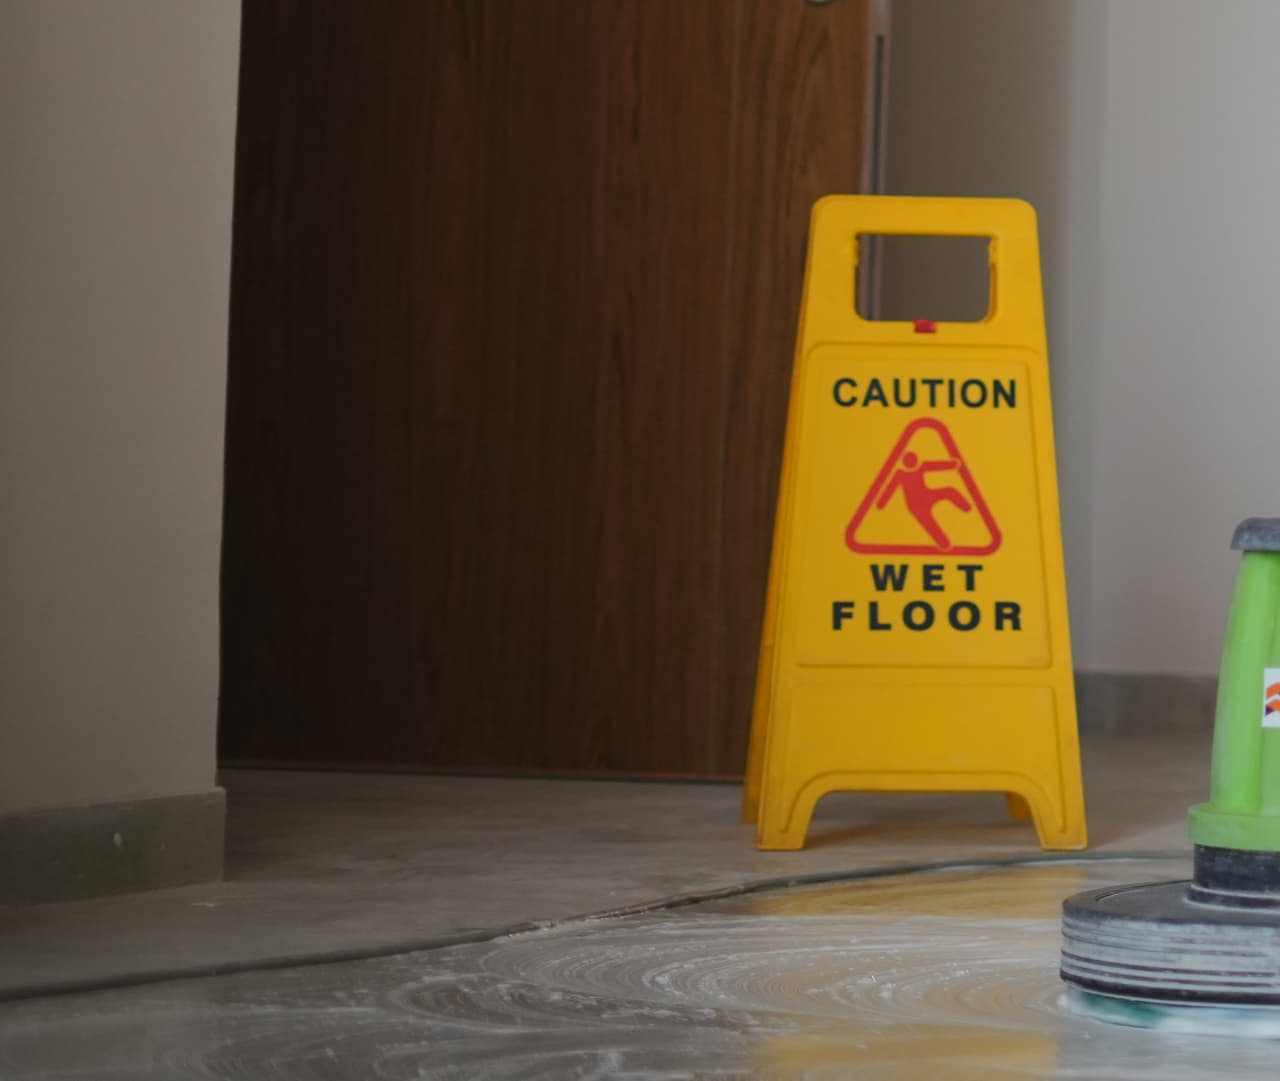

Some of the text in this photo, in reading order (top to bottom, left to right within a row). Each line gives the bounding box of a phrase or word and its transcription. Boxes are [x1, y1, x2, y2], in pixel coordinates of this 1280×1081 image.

[832, 377, 1016, 409] CAUTION
[870, 563, 983, 593] WET
[831, 600, 1022, 632] FLOOR
